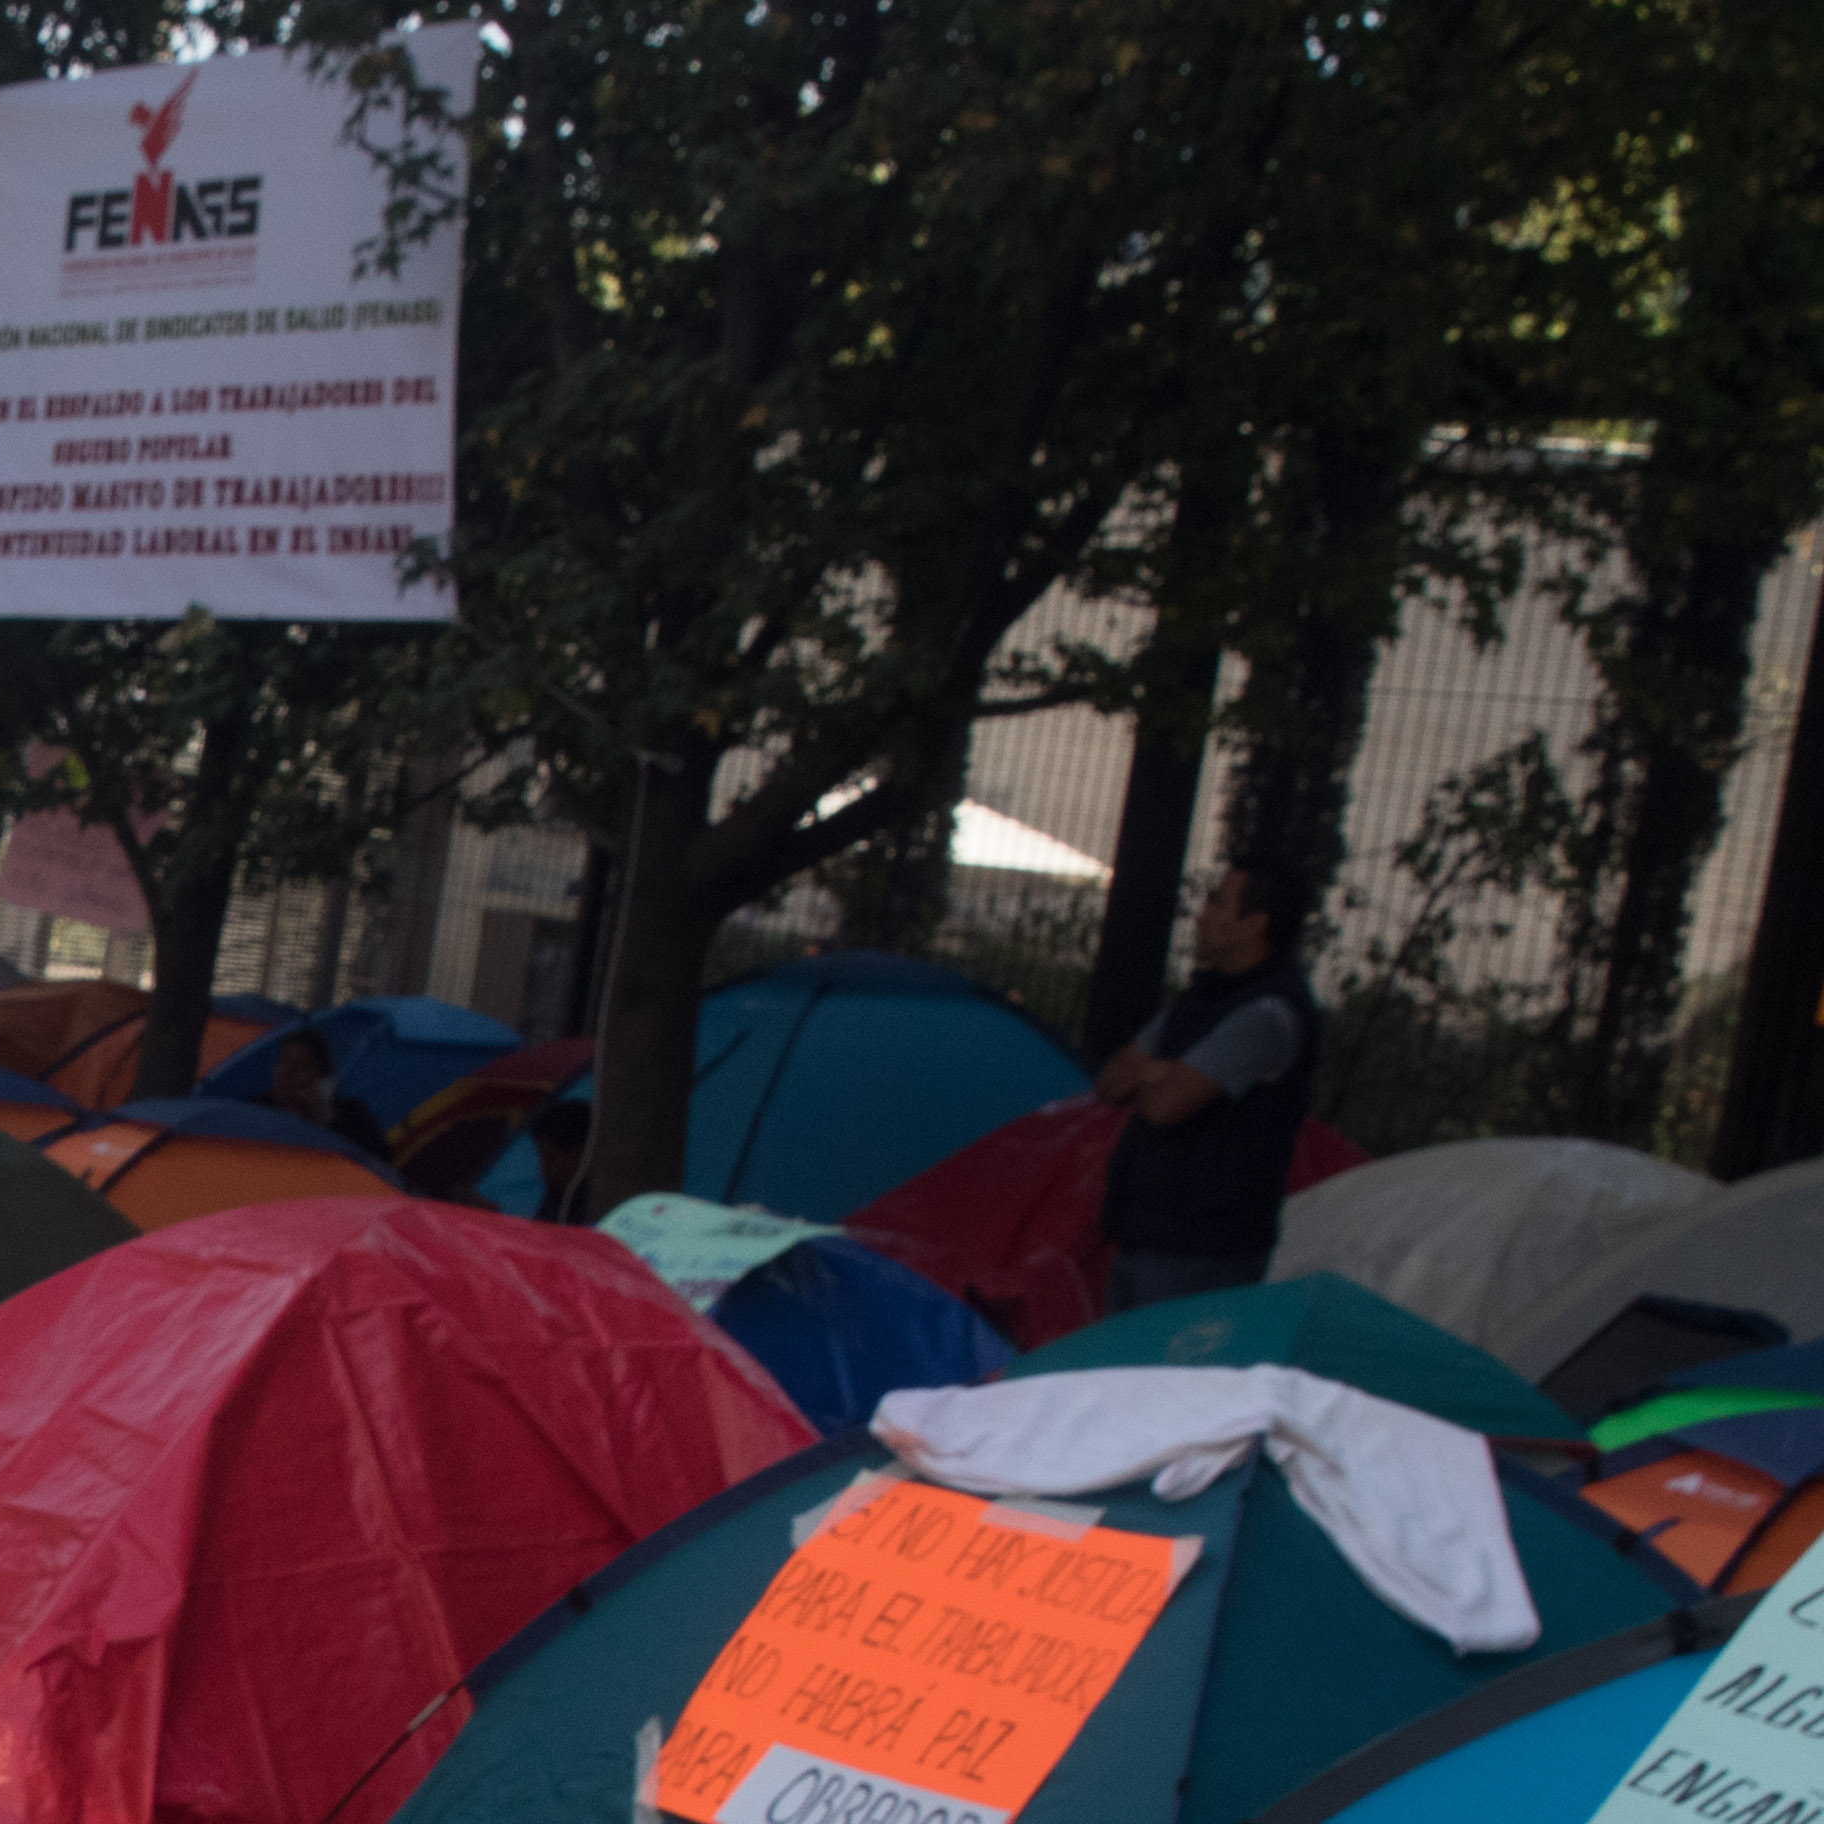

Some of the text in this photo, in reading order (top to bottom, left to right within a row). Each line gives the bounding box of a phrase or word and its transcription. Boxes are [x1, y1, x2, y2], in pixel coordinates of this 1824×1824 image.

[26, 319, 108, 349] NACIONAL
[114, 315, 140, 344] DE
[144, 309, 248, 341] SINDICATOS
[255, 306, 278, 336] DE
[284, 302, 345, 334] SALUD
[217, 376, 384, 416] TRABAJADORES
[392, 374, 438, 407] DEL
[51, 431, 232, 468] SEGURO POPULAR
[71, 477, 166, 514] MASIVO
[172, 474, 205, 509] DE
[131, 523, 239, 560] LABORAL
[248, 524, 280, 557] EN
[879, 1503, 955, 1563] NO
[945, 1525, 1049, 1592] HAY
[757, 1555, 871, 1639] PARA
[860, 1590, 926, 1656] EL
[704, 1633, 1017, 1785] NO HABRÁ PAZ
[655, 1718, 753, 1807] PARA
